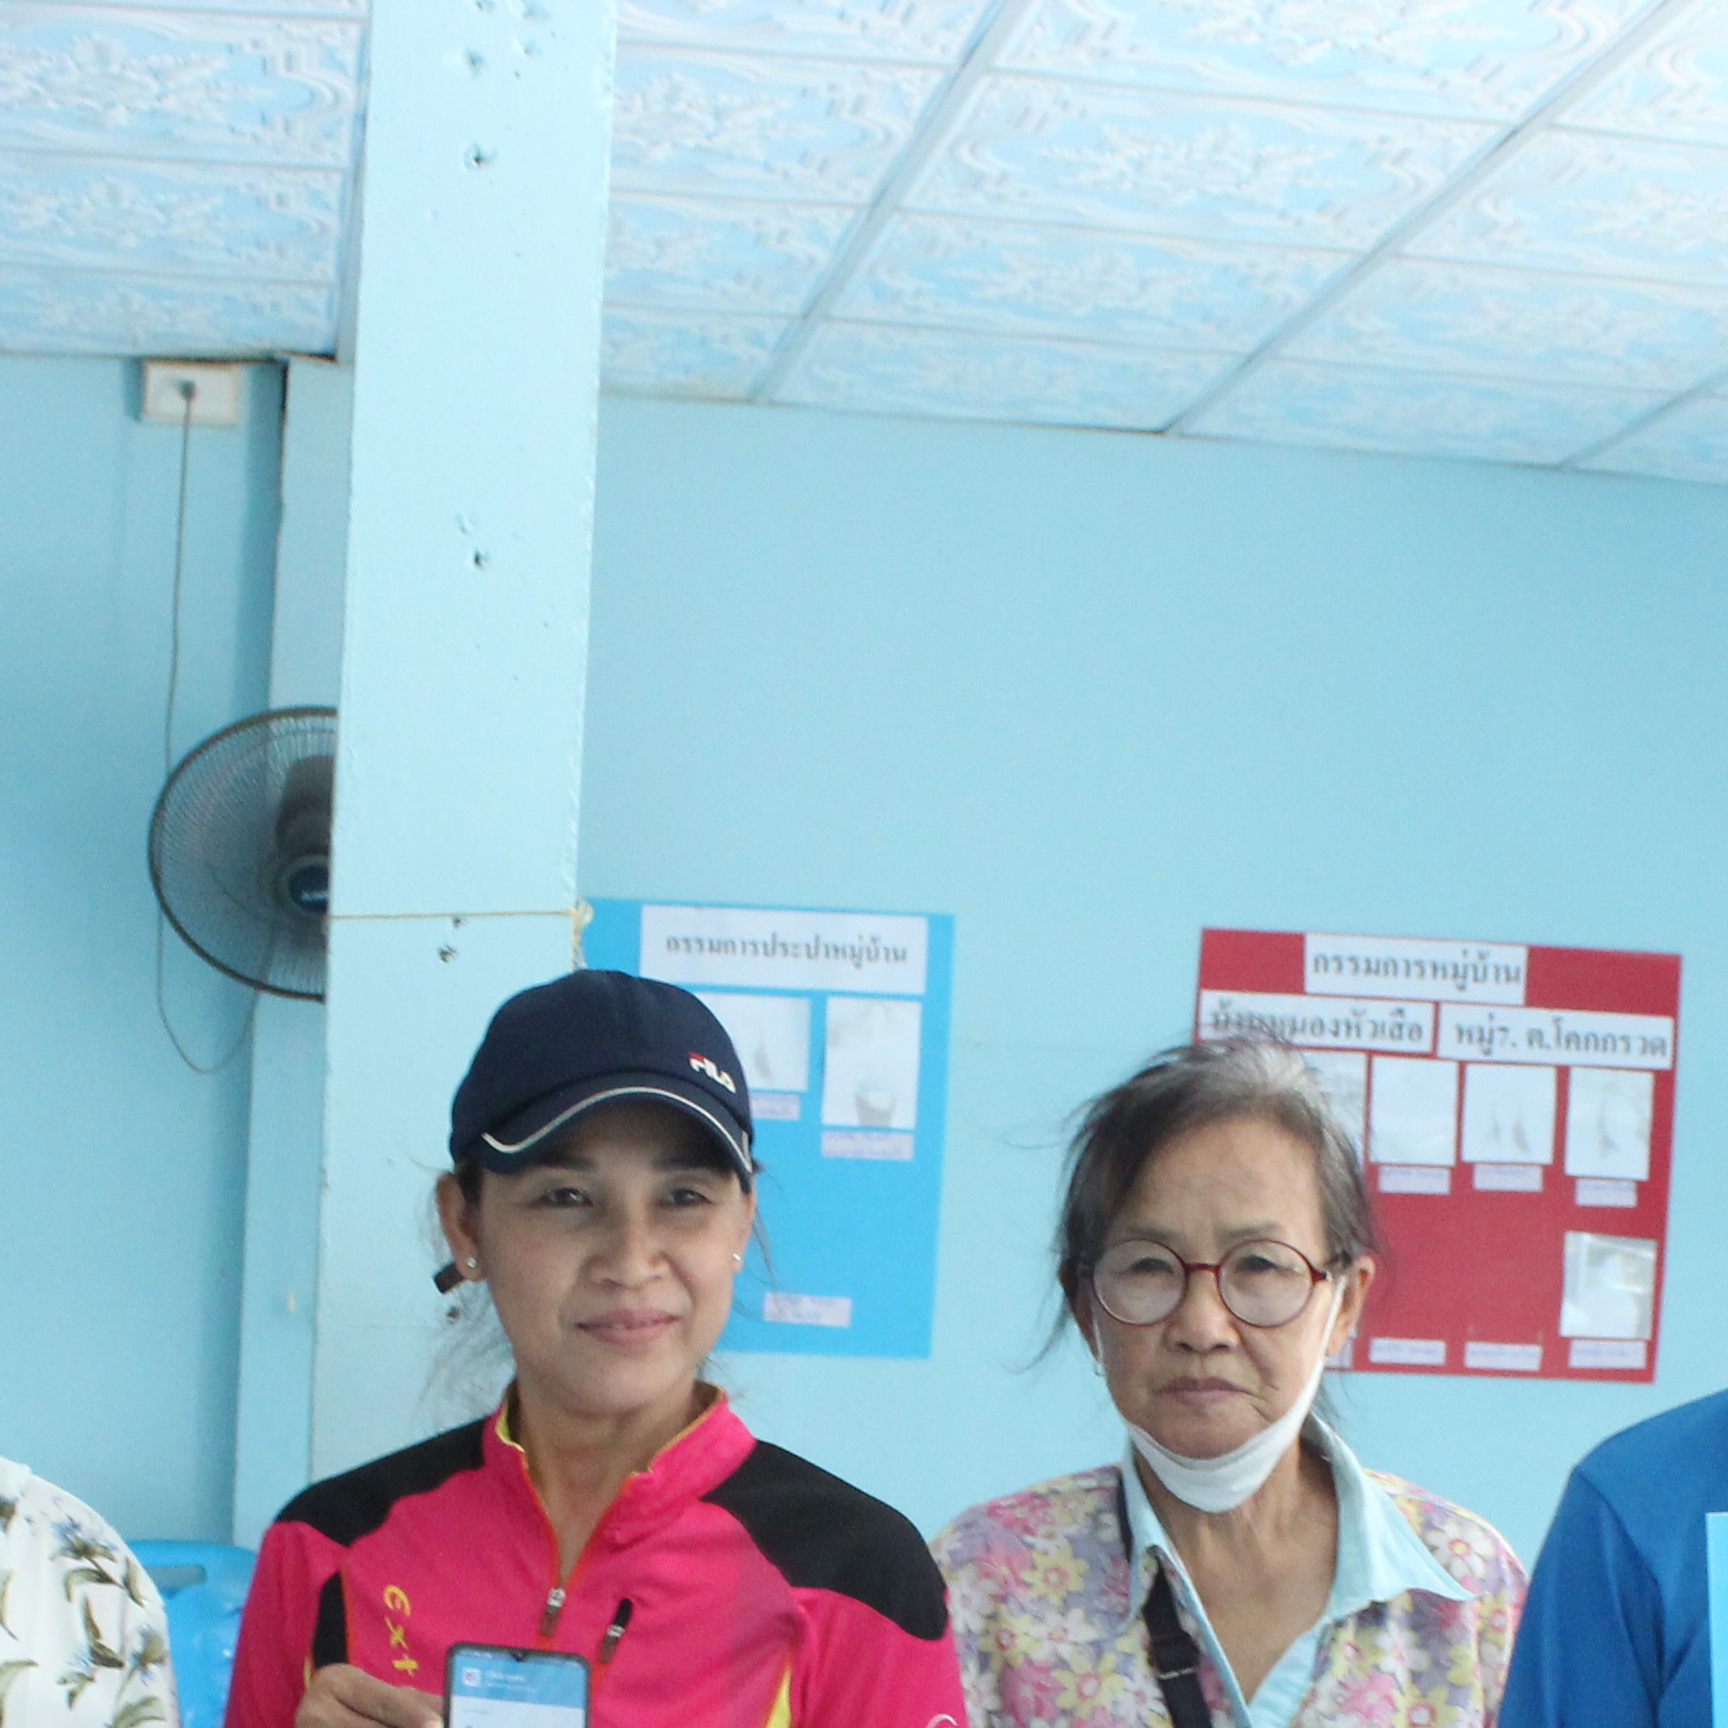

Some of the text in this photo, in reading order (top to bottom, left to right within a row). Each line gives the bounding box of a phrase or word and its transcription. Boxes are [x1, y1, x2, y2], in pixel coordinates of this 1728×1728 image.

[1313, 948, 1521, 992] กรรมการหมู่บ้าน
[688, 1051, 736, 1093] FILA
